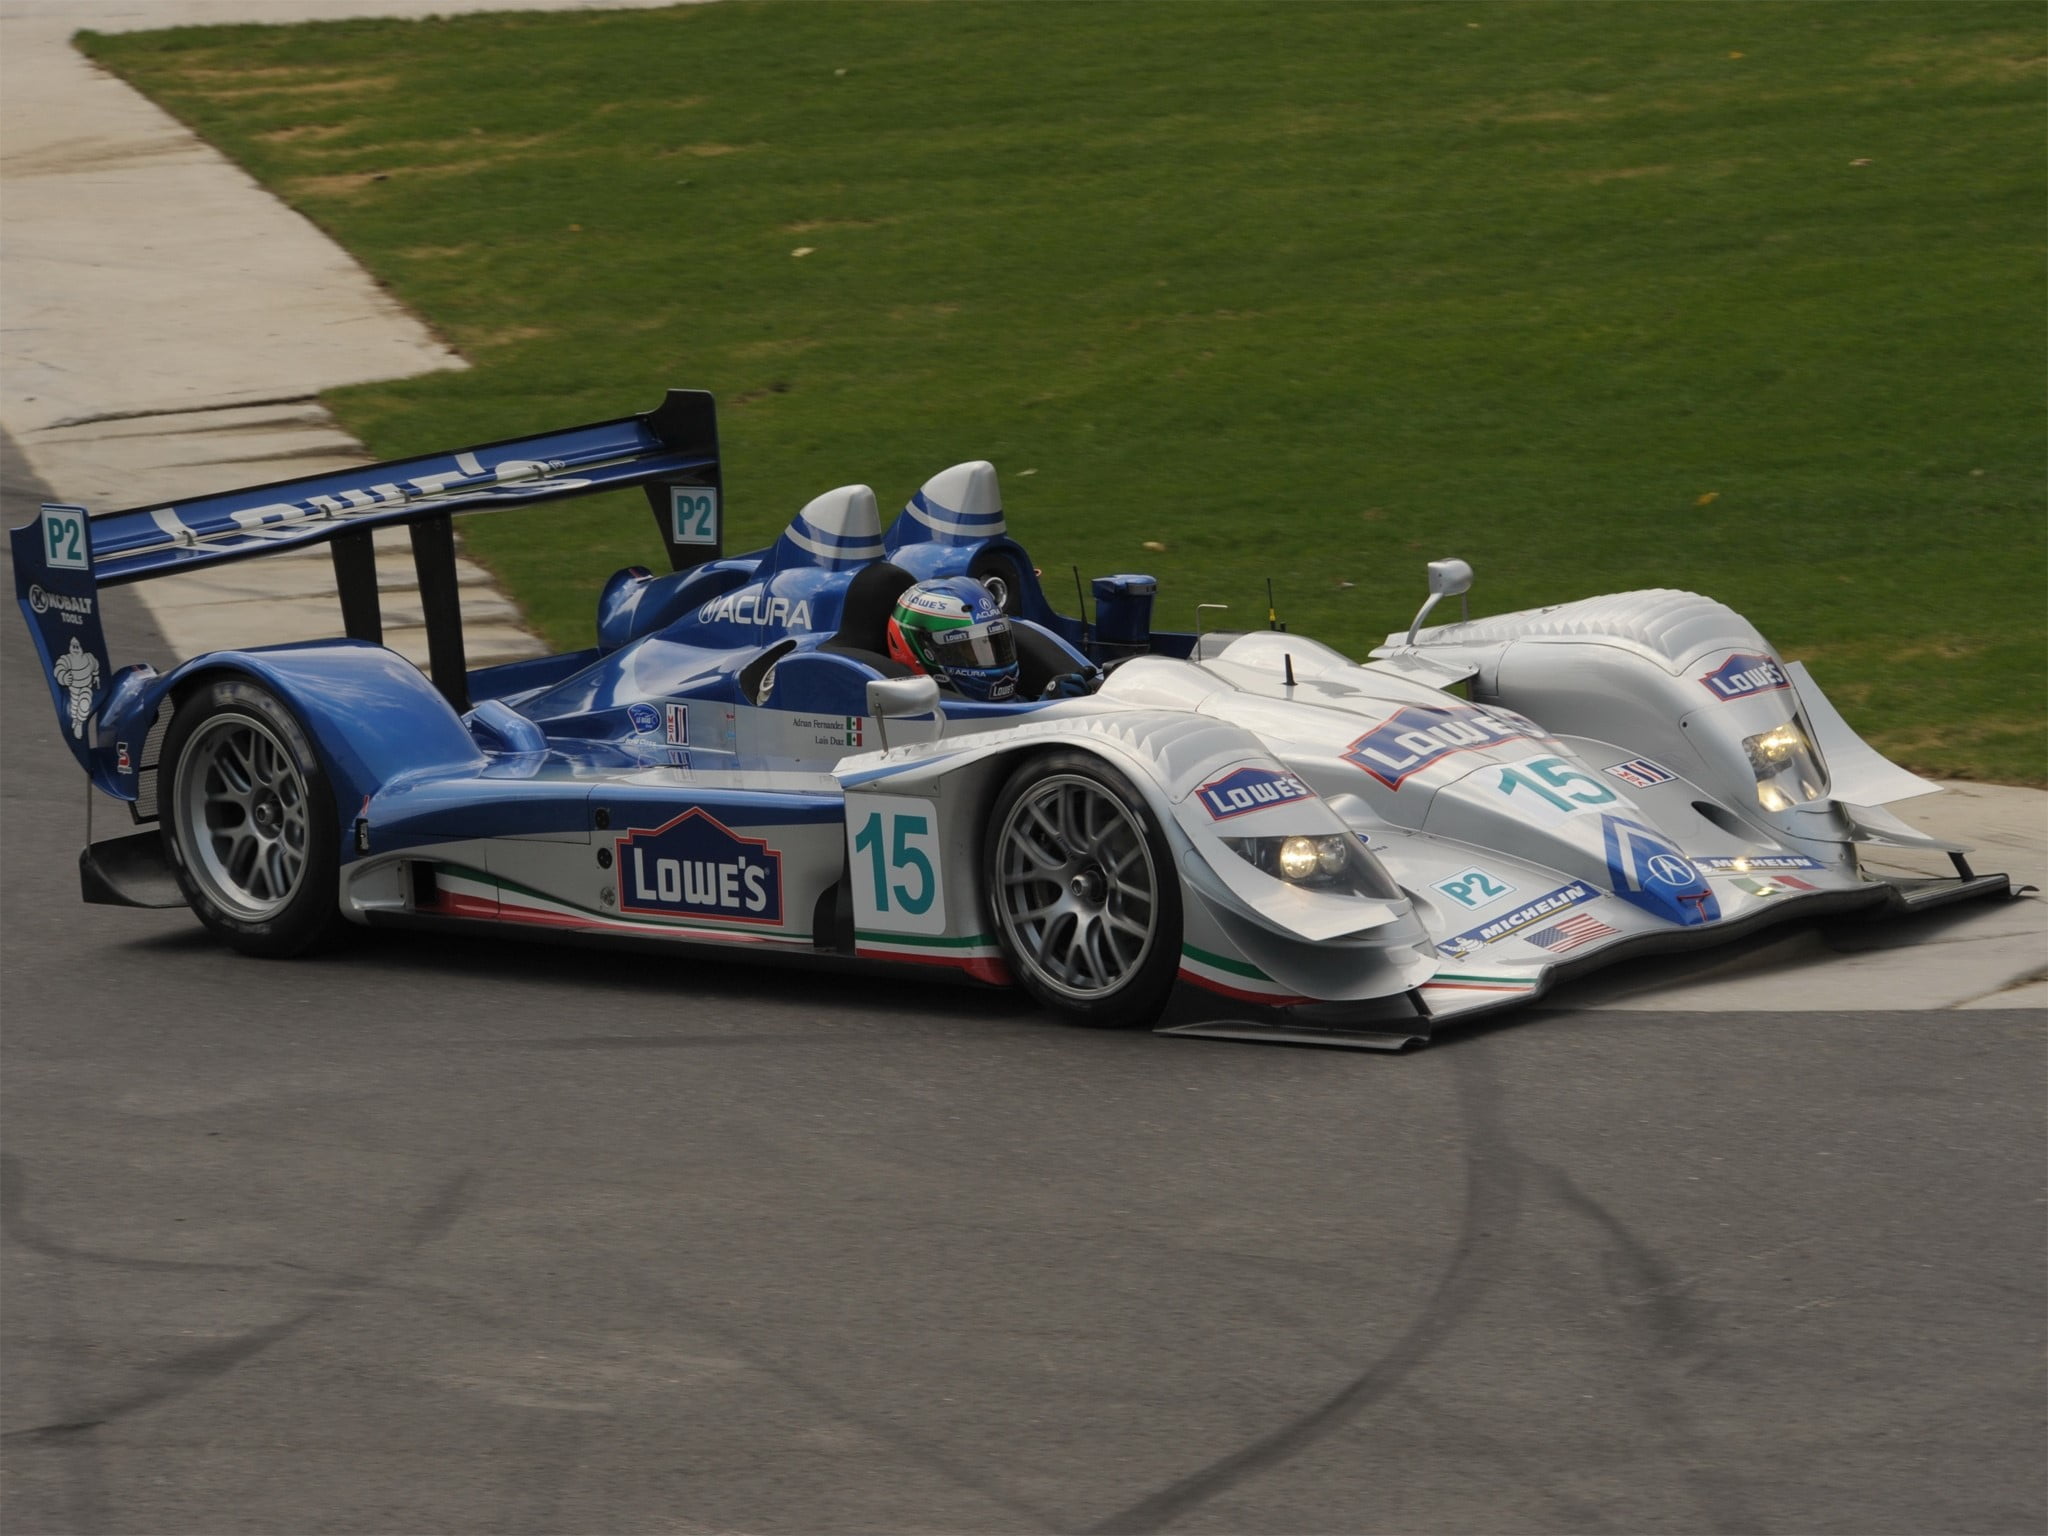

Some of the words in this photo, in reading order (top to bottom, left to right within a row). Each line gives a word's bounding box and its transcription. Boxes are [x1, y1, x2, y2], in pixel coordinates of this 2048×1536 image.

[676, 495, 712, 536] P2
[47, 517, 82, 561] P2
[46, 592, 92, 614] KOBALT
[61, 612, 83, 625] TOOLS
[715, 596, 812, 631] ACURA
[976, 608, 1002, 620] ACURA
[955, 669, 986, 678] ACURA
[1711, 661, 1784, 695] LOWE'S
[667, 706, 675, 743] IMSA
[1207, 776, 1308, 813] LOWE'S
[1498, 758, 1618, 812] 15
[633, 847, 767, 912] LOWE'S
[855, 812, 936, 915] 15
[1440, 873, 1507, 906] P2
[1480, 885, 1586, 939] MICHELIN
